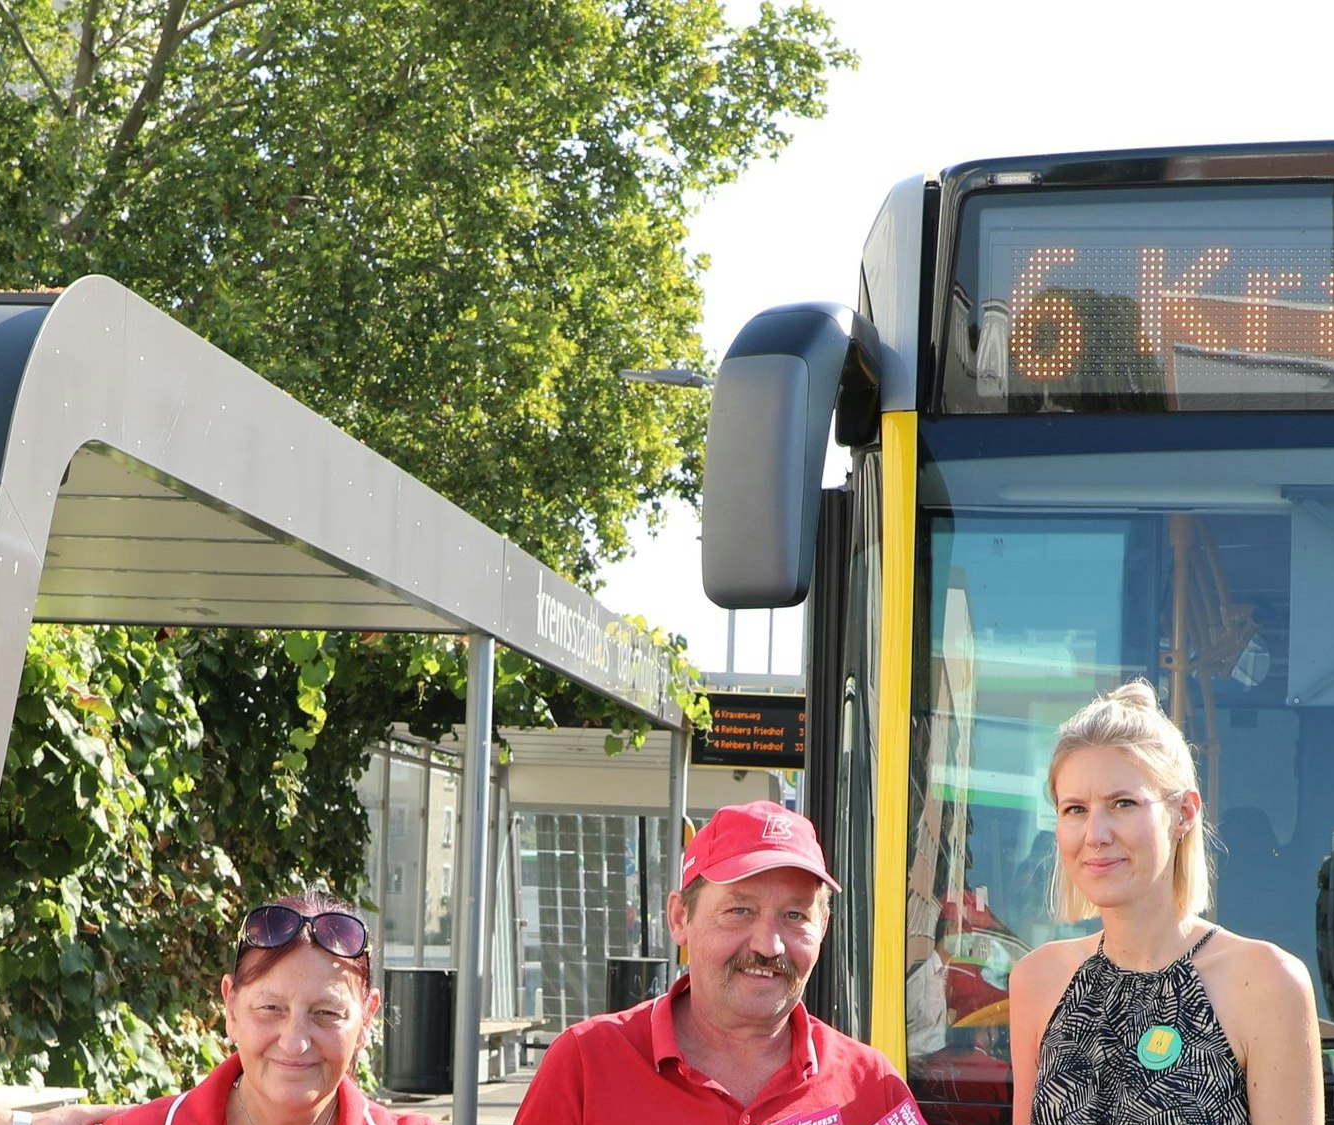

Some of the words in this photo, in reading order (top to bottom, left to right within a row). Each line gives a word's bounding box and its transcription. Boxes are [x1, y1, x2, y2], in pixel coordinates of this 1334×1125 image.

[1011, 247, 1081, 377] 6
[720, 726, 751, 735] Rehberg
[754, 727, 784, 737] Friedhof
[720, 741, 751, 750] Rehberg
[753, 742, 784, 751] Friedhof
